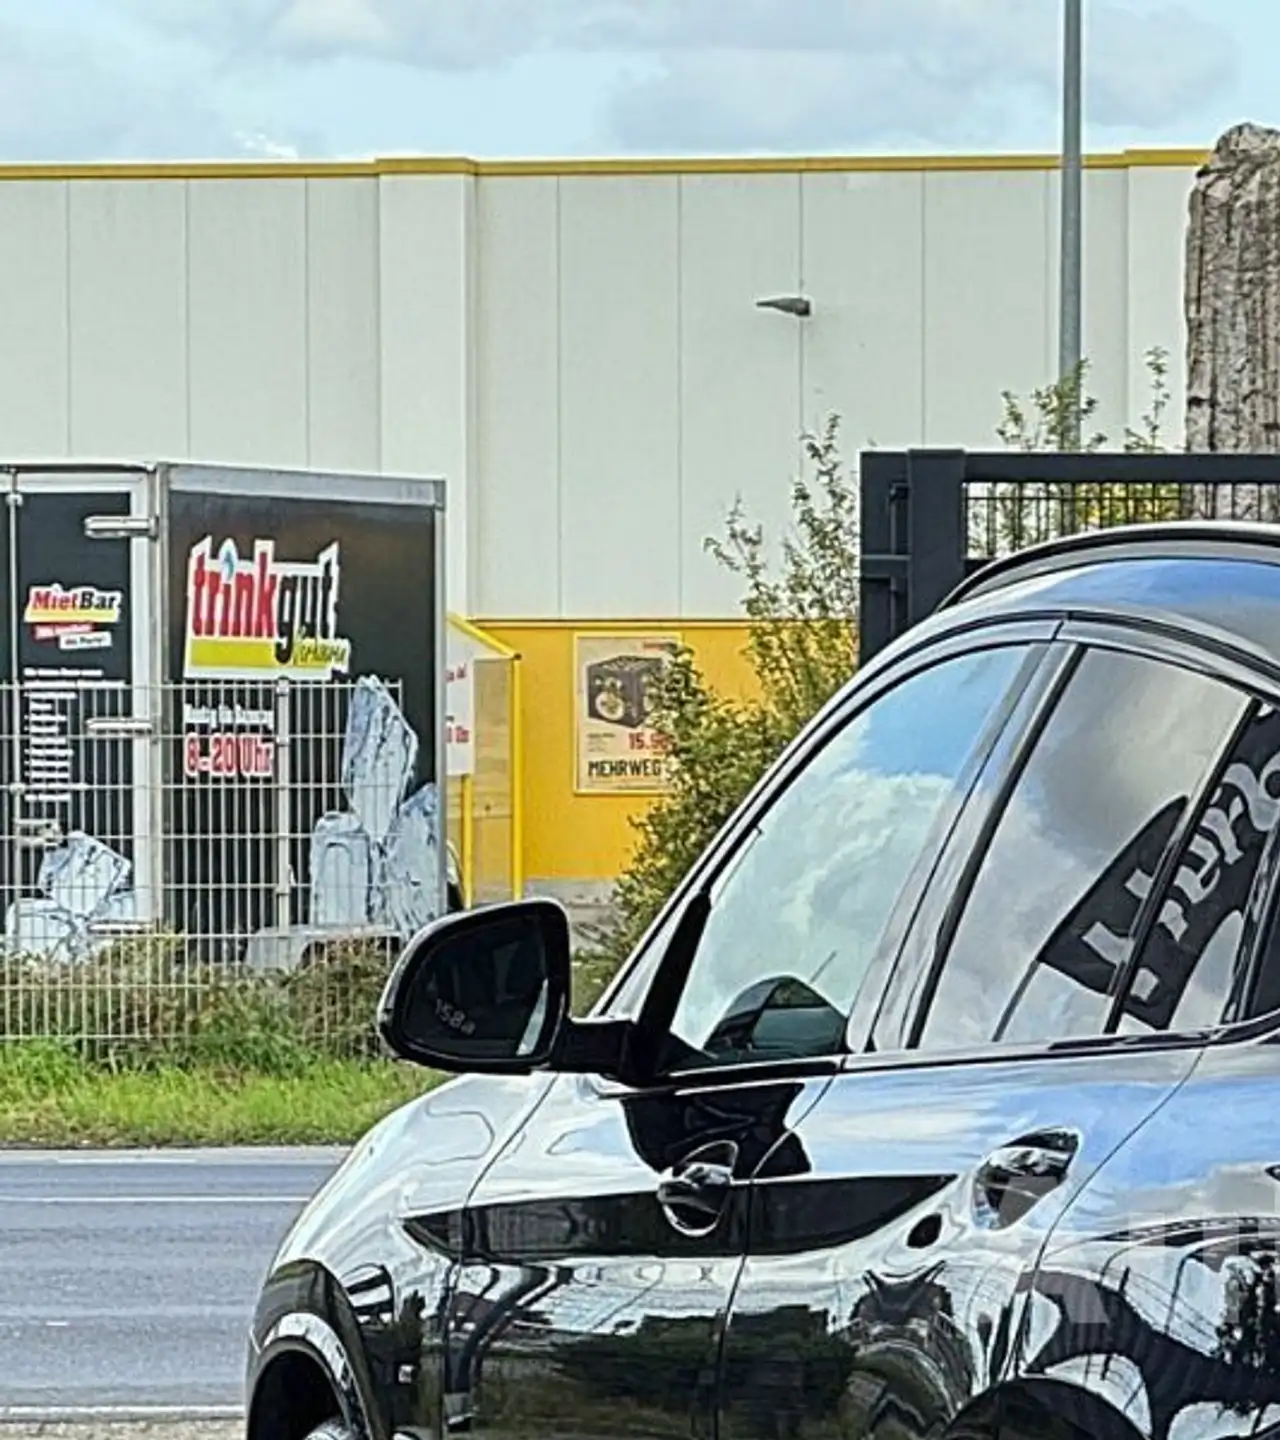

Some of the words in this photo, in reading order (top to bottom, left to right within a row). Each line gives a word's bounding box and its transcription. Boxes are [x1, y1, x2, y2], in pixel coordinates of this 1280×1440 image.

[31, 589, 118, 611] MietBar
[192, 550, 335, 664] trinkgut
[587, 759, 662, 778] MEHRWEG
